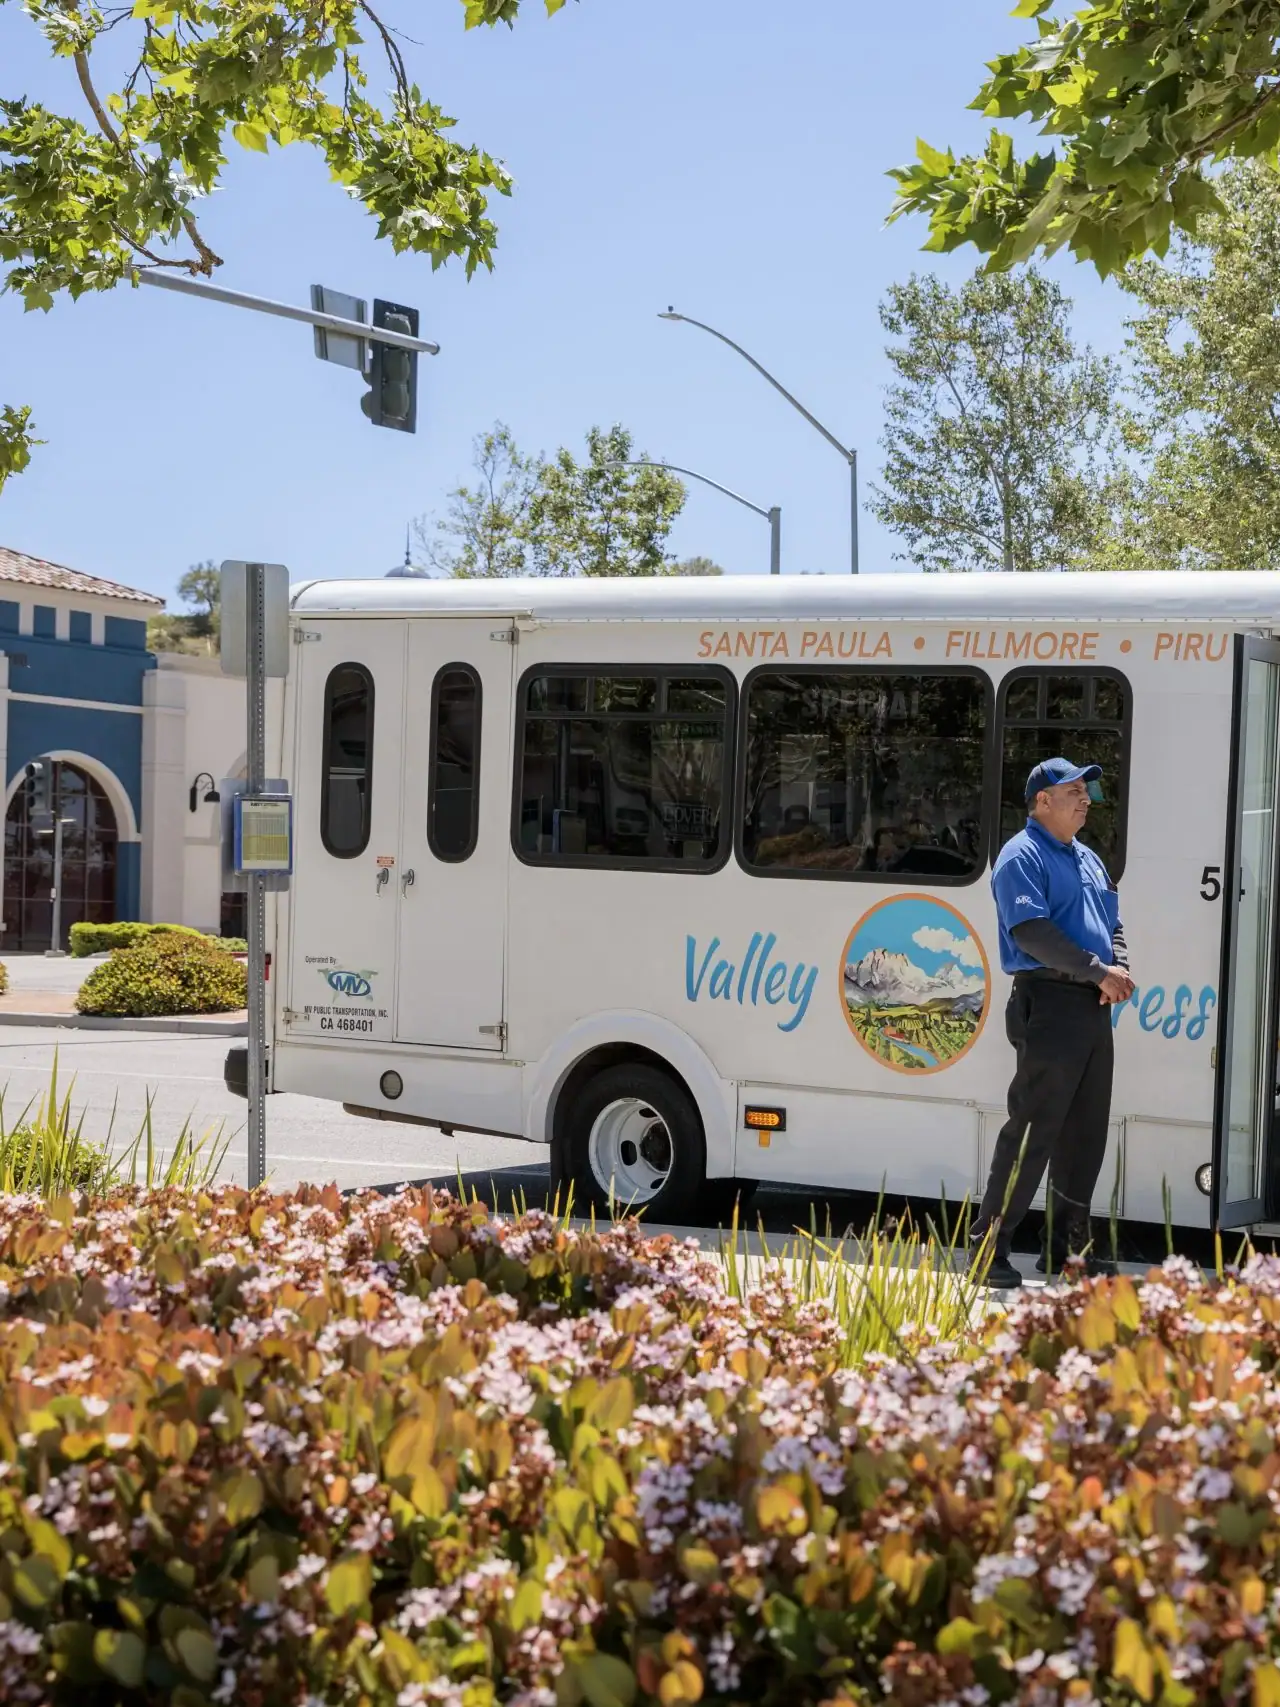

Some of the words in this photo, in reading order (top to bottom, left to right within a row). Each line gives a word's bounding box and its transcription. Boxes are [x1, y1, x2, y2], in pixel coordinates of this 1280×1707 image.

[698, 630, 789, 658] SANTA
[800, 631, 893, 658] PAULA
[945, 630, 1101, 660] FILLMORE
[1154, 632, 1228, 662] PIRU
[305, 955, 329, 965] Operated
[335, 975, 364, 994] MV
[686, 932, 818, 1033] Valley
[313, 1006, 332, 1015] PUBLIC
[378, 1009, 389, 1018] INC.
[1111, 984, 1217, 1041] ress
[320, 1017, 334, 1030] CA
[336, 1018, 373, 1032] 468401
